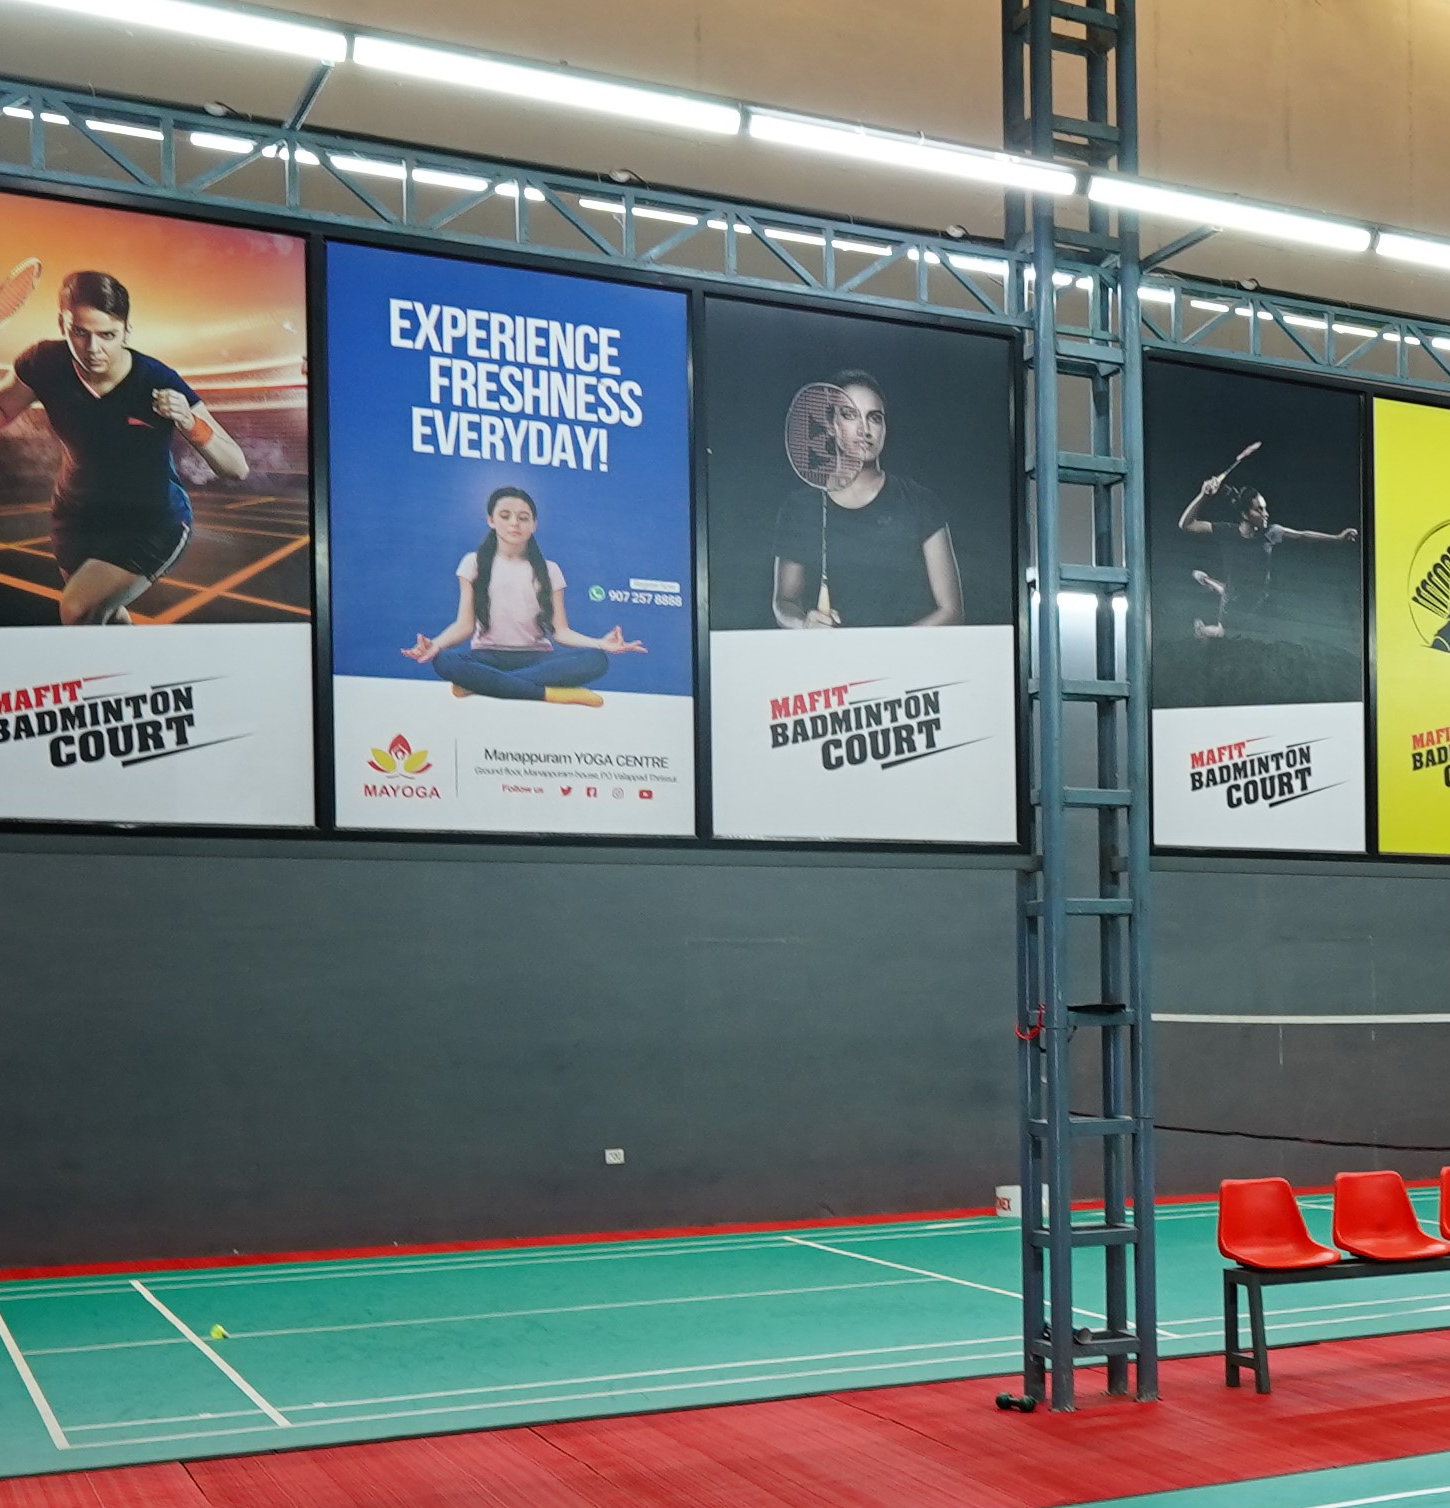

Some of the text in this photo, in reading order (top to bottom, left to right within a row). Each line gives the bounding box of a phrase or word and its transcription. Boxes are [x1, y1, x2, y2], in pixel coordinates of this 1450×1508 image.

[390, 298, 621, 375] EXPERIENCE
[429, 355, 642, 427] FRESHNESS
[412, 406, 608, 472] EVERYDAY!
[608, 589, 630, 602] 907
[770, 685, 848, 720] MAFIT
[770, 691, 940, 748] BADMINTON
[50, 714, 194, 767] COURT
[484, 748, 669, 769] Manappuram YOGA CENTRE
[821, 718, 941, 770] COURT
[1190, 741, 1246, 769] MAFIT
[364, 784, 441, 799] MAYOGA
[1190, 745, 1311, 792] BADMINTON
[1226, 767, 1312, 808] COURT
